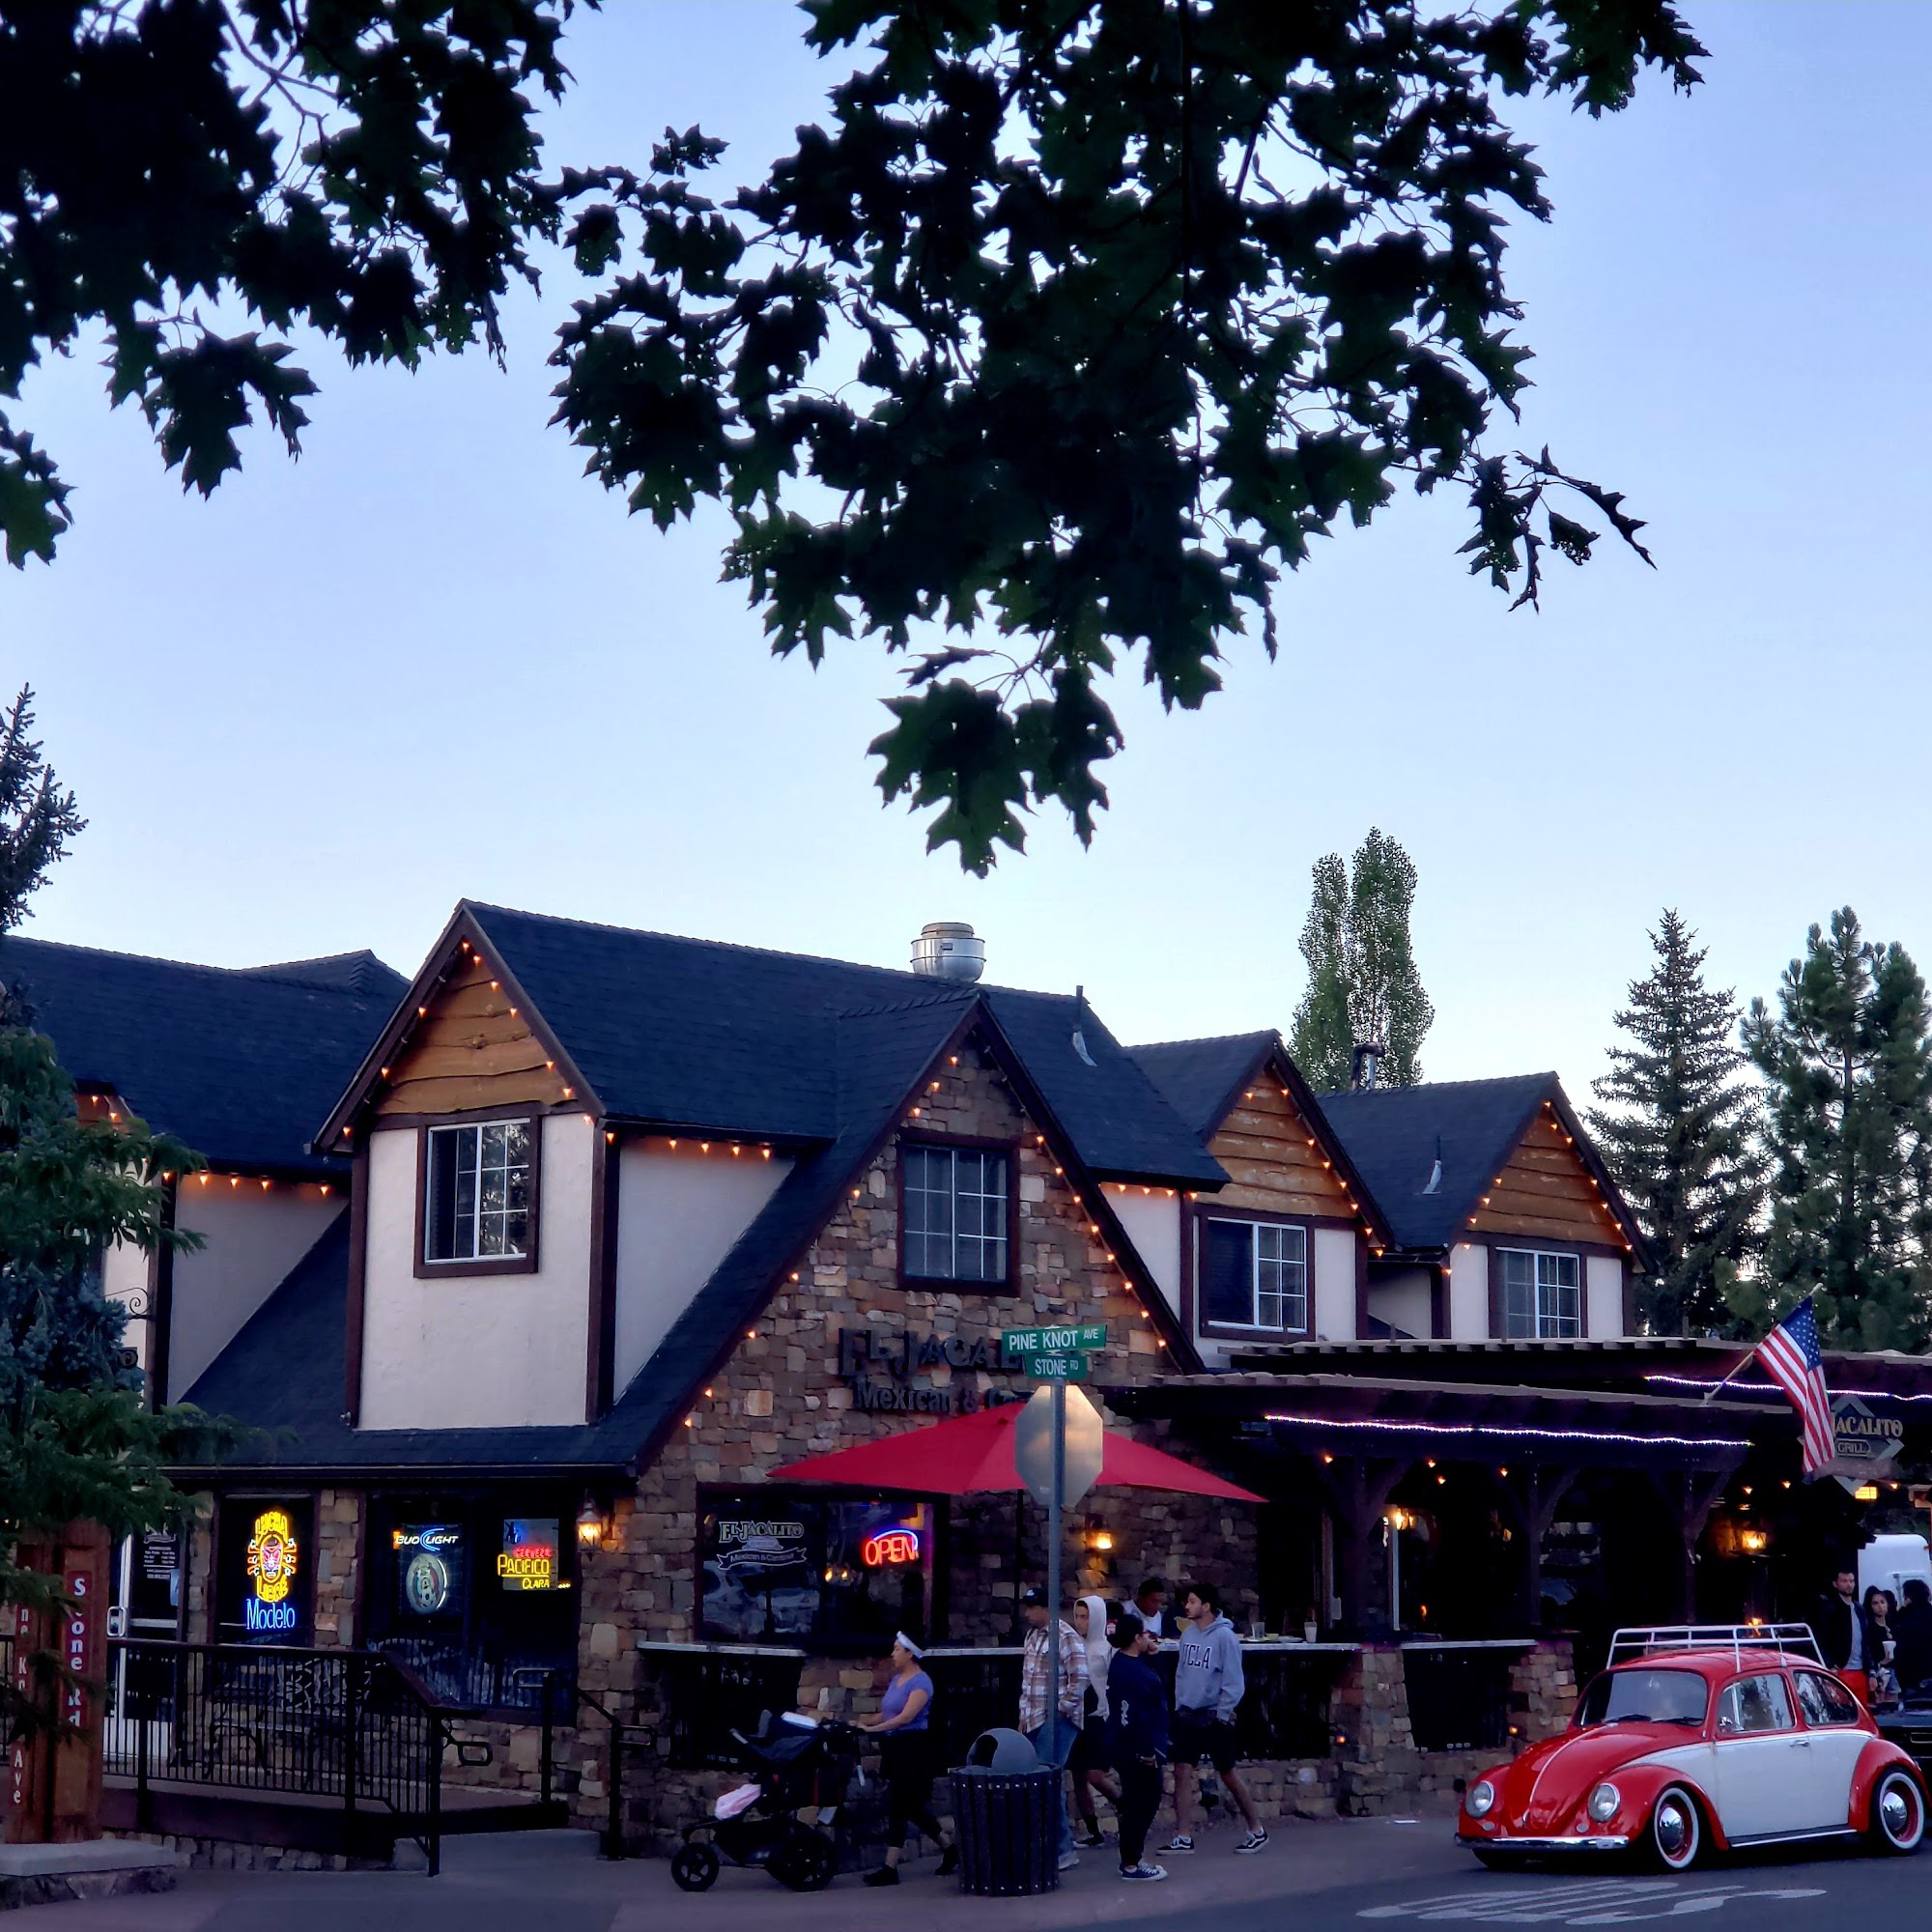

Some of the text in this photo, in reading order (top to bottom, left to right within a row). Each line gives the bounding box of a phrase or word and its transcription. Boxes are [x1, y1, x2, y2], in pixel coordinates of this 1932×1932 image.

[1009, 1328, 1099, 1351] PINE KNOT AVE
[892, 1330, 1024, 1379] JACAL
[1035, 1358, 1079, 1376] STONE RD
[855, 1378, 954, 1413] Mexican
[1837, 1441, 1870, 1454] GRILL
[254, 1511, 290, 1547] LUCHA
[395, 1536, 459, 1545] BUD LIGHT
[721, 1522, 804, 1541] EL JACALITO
[497, 1553, 550, 1576] PACIFICO
[865, 1536, 916, 1565] OPEN
[256, 1574, 289, 1604] LIBRE
[523, 1577, 550, 1590] CLARA
[71, 1577, 87, 1671] Sone
[246, 1599, 296, 1630] Modelo
[13, 1748, 23, 1804] Ave
